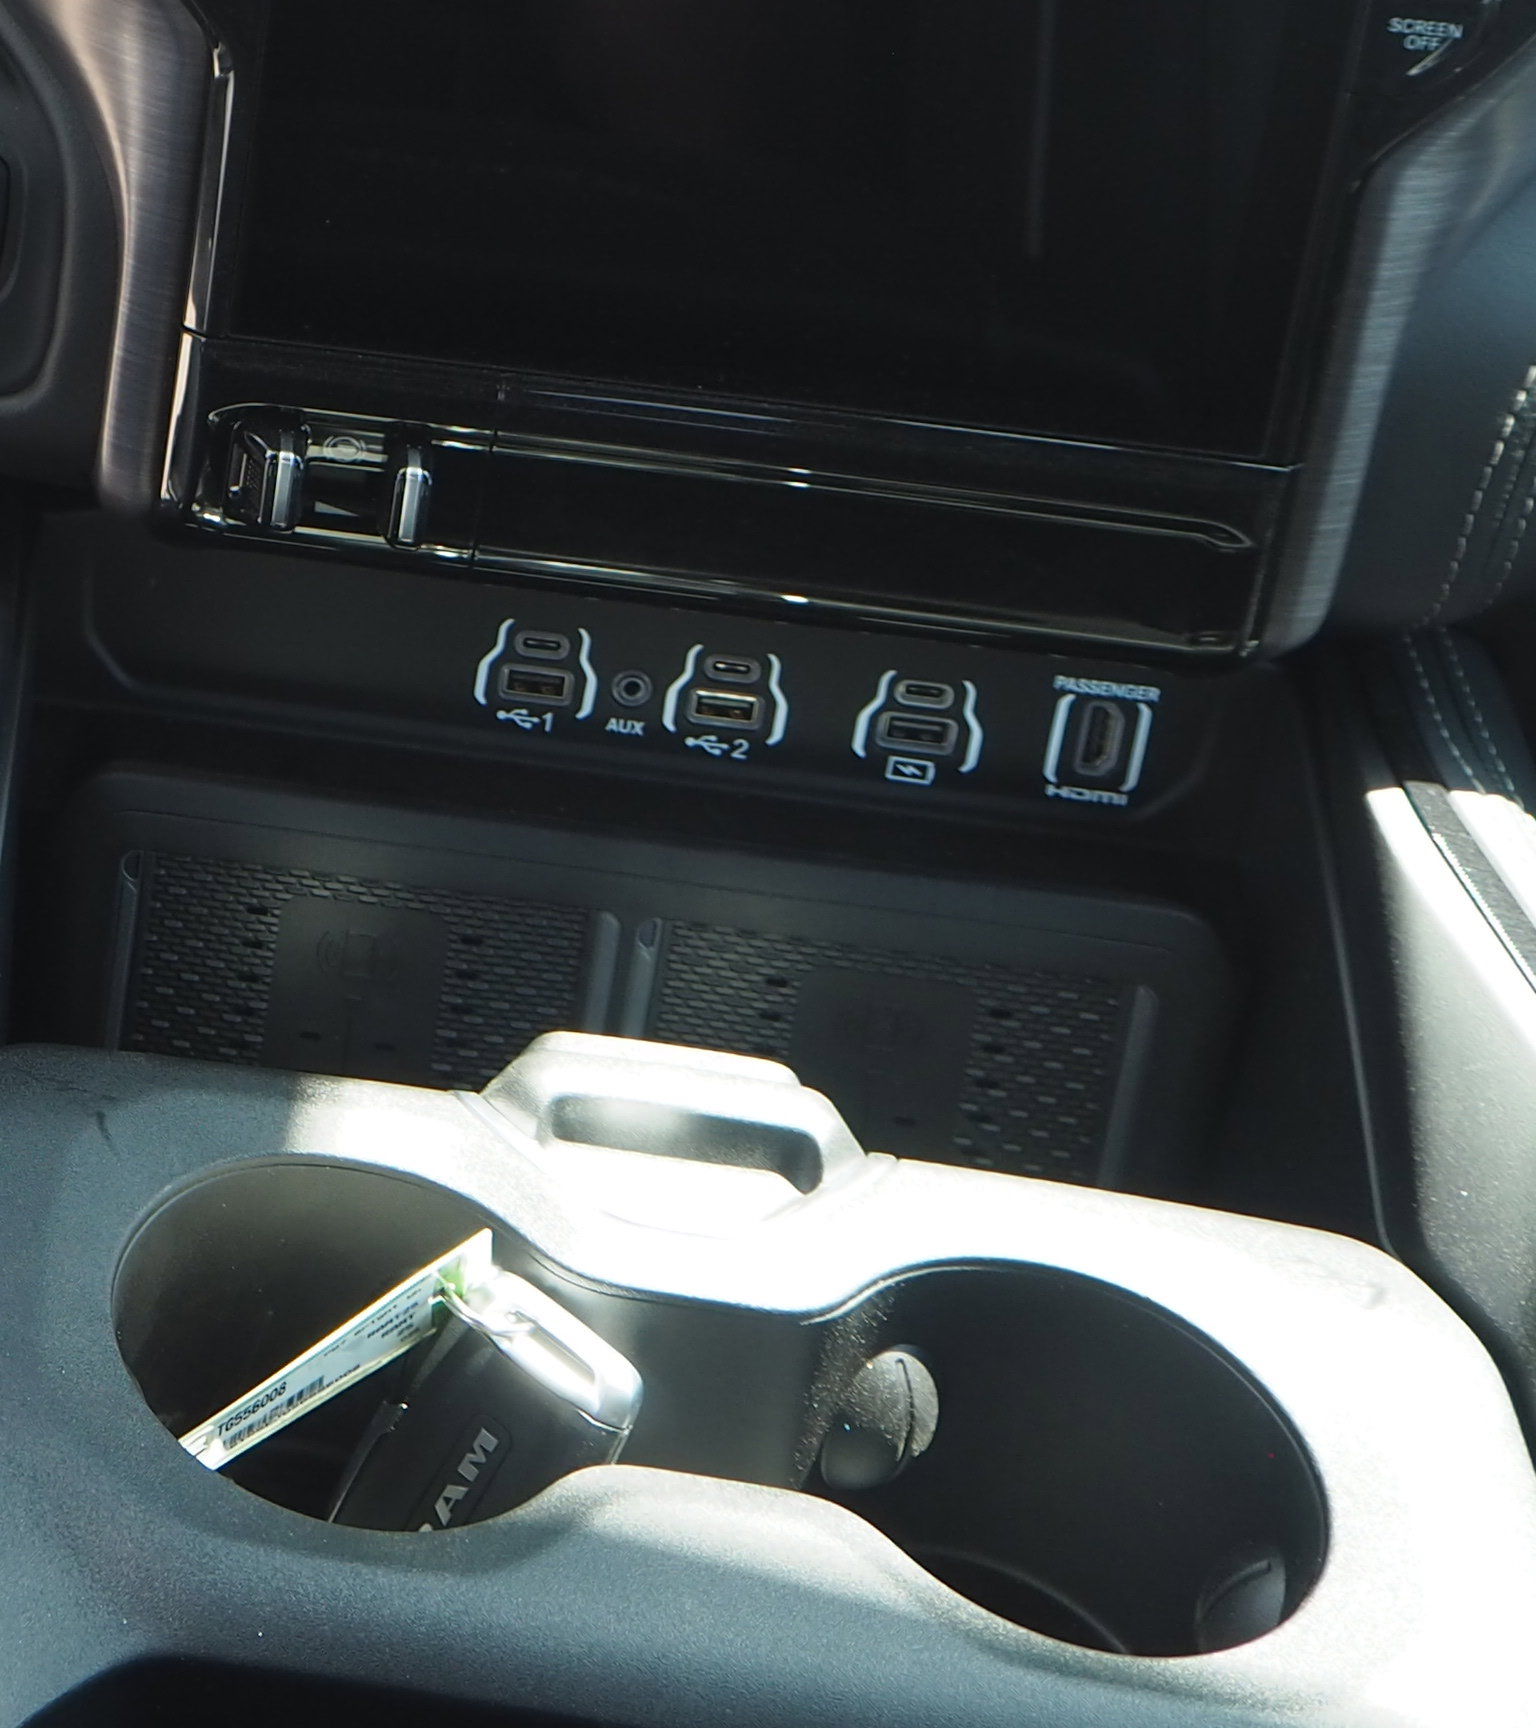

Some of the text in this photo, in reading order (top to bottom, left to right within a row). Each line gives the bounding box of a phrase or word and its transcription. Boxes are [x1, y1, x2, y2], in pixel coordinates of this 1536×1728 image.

[1387, 17, 1464, 39] SCREEN
[1053, 674, 1161, 703] PASSENGER
[605, 718, 645, 736] AUX
[421, 1427, 499, 1531] AM
